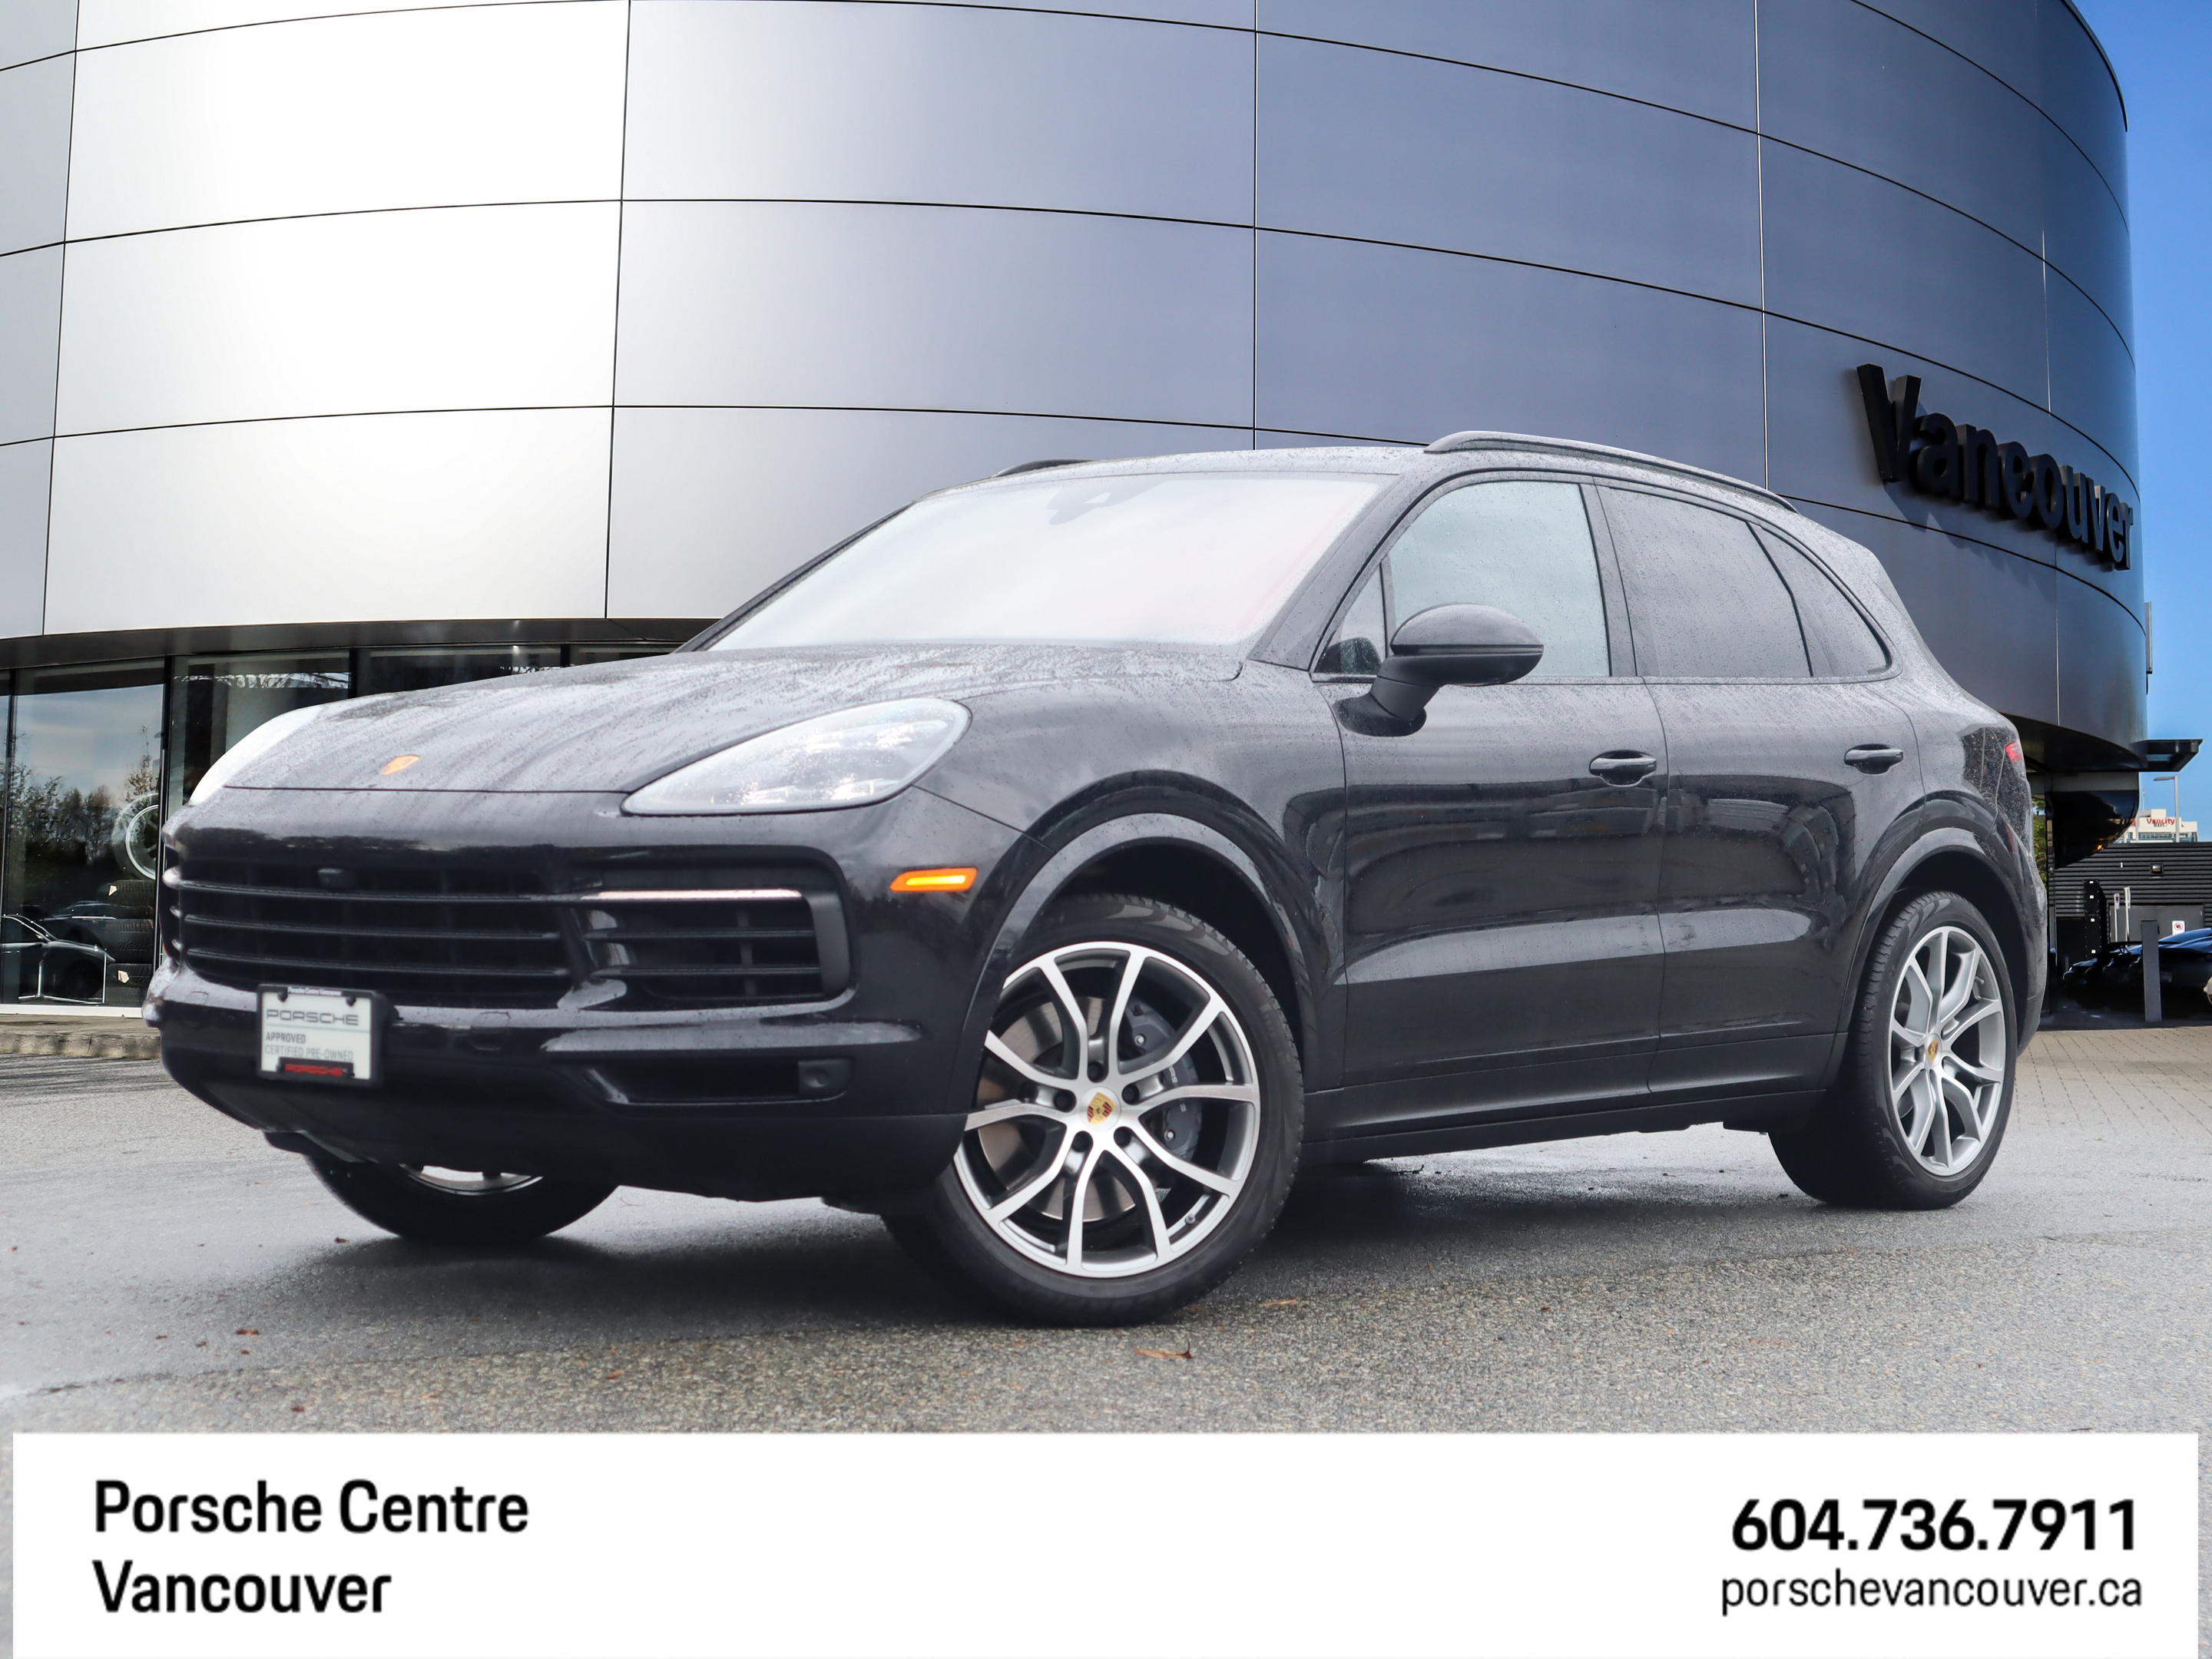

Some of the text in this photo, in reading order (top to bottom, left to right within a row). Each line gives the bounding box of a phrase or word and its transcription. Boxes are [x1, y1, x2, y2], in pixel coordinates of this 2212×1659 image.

[1856, 363, 2134, 571] Vancouver
[266, 1009, 359, 1026] PORSCHE
[265, 1031, 306, 1045] APPROVED
[264, 1045, 353, 1061] CERTIFIED PRE-OWNED
